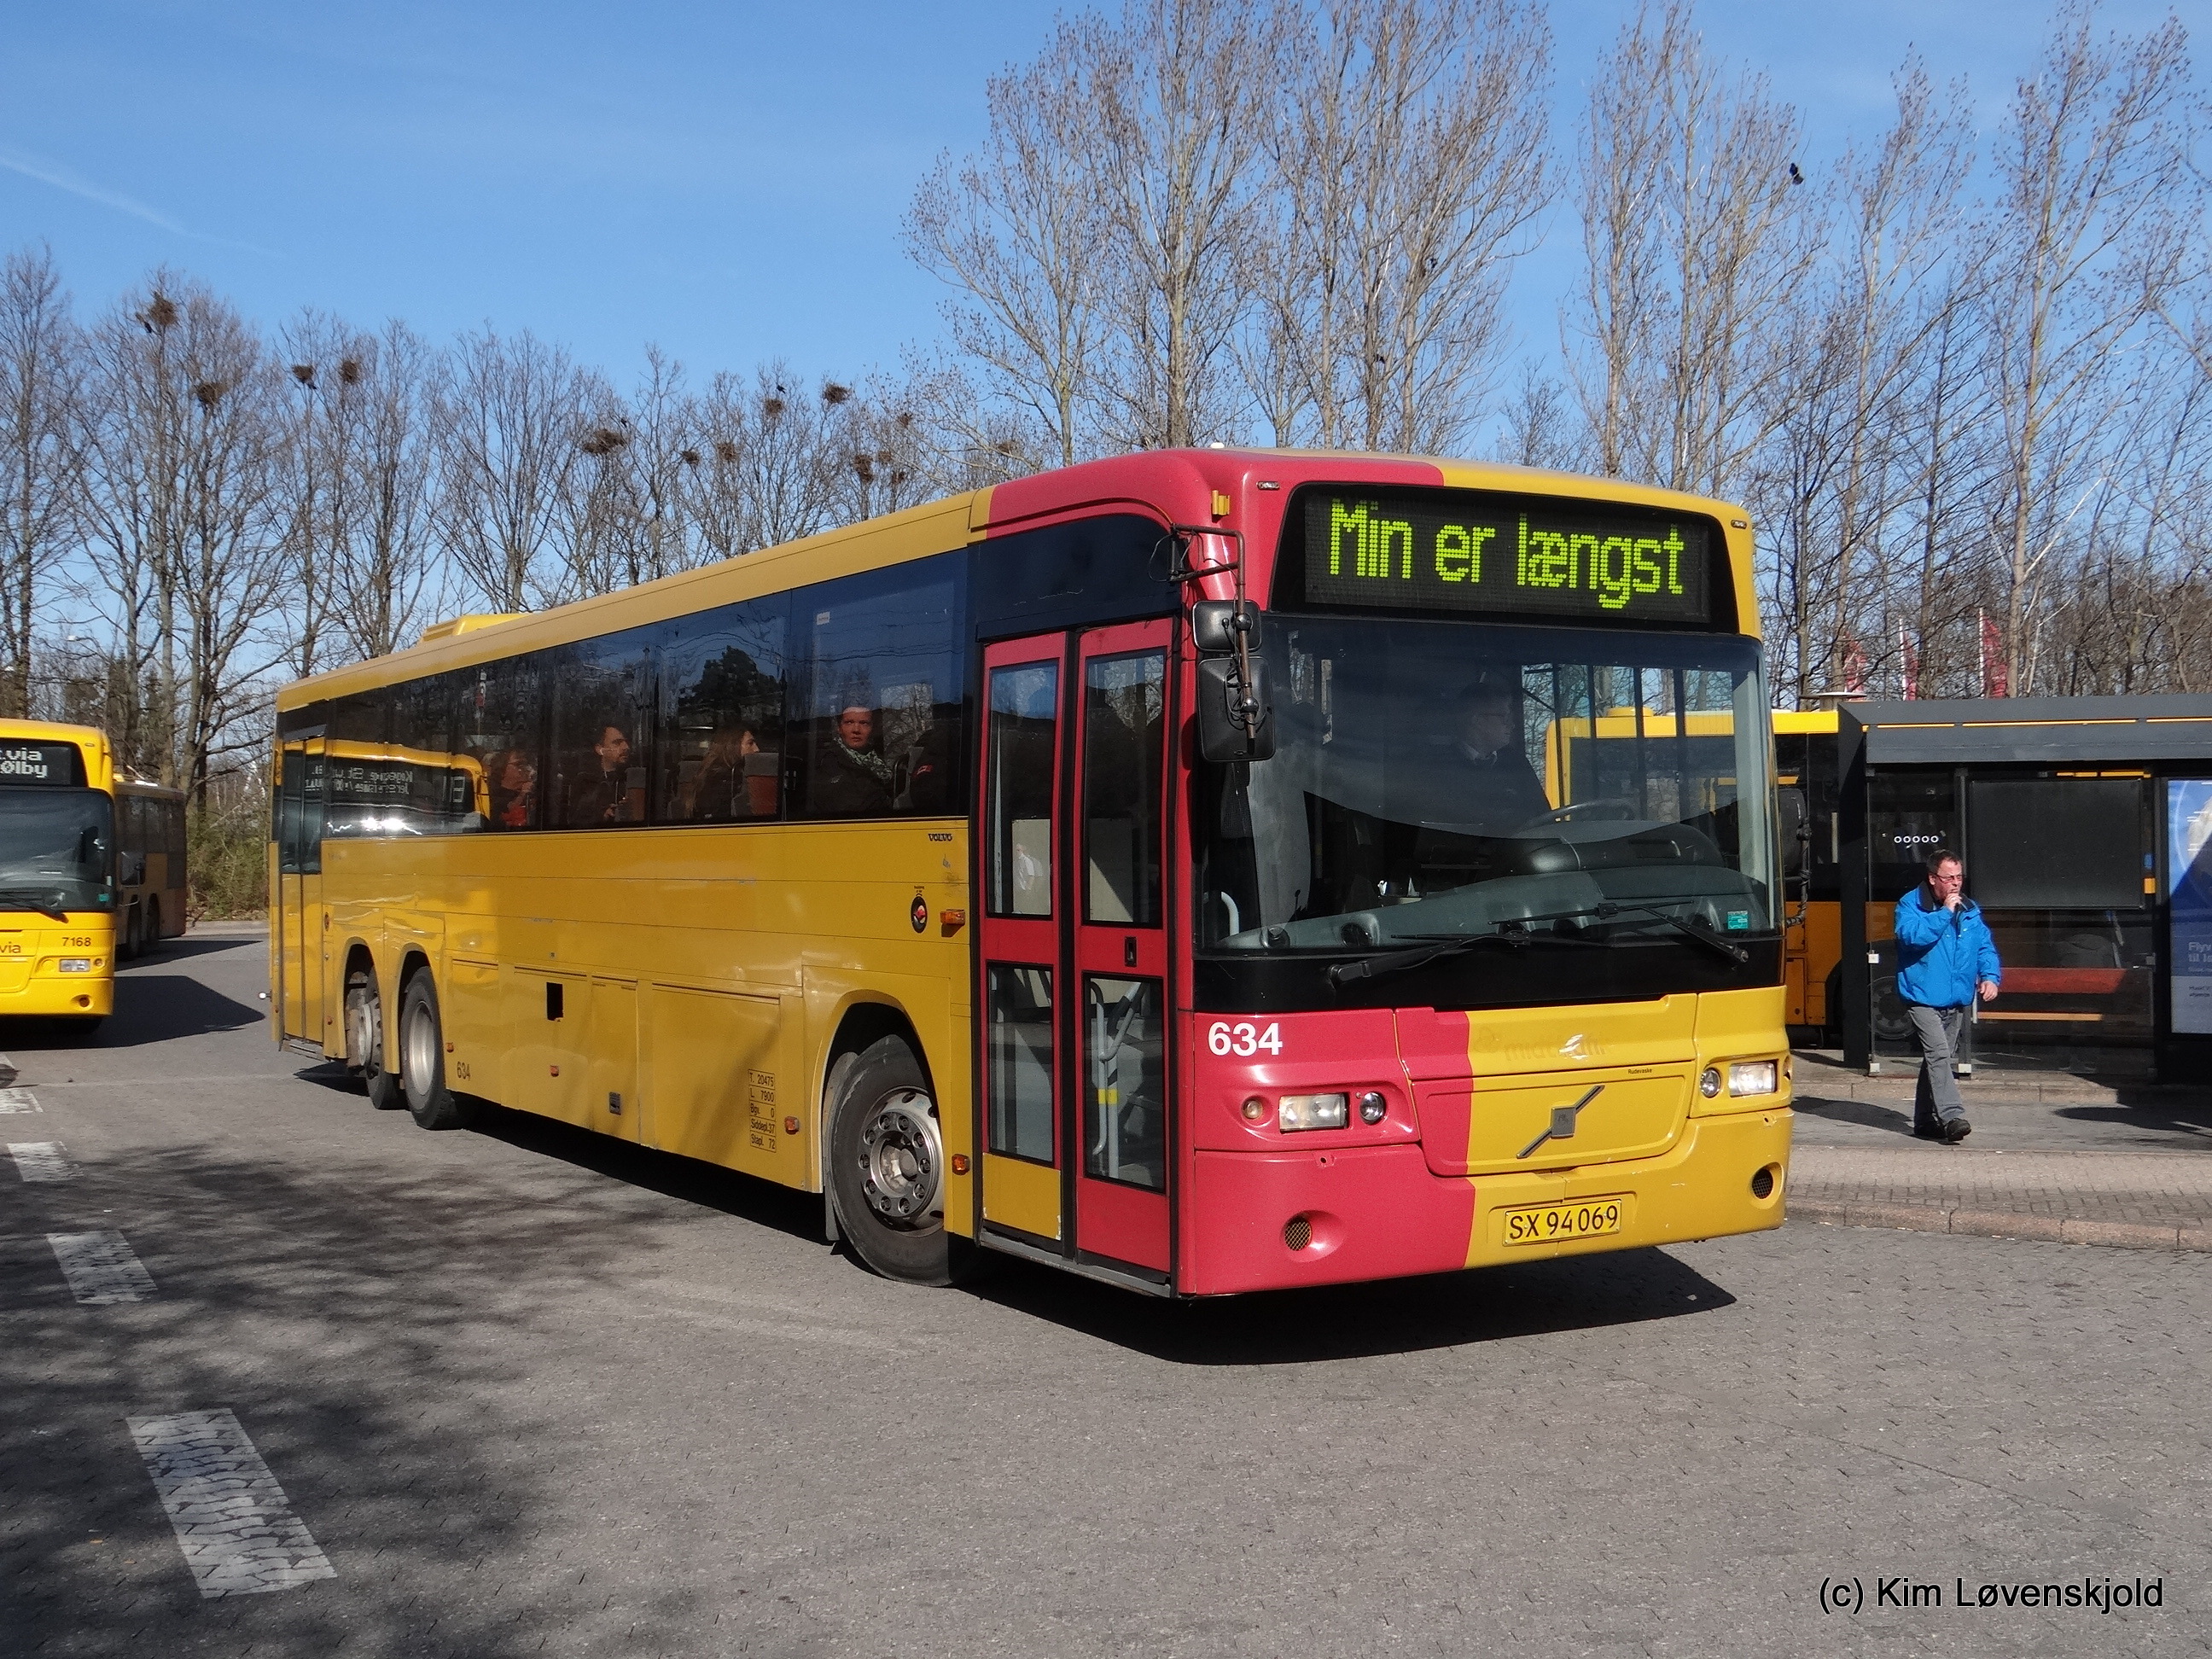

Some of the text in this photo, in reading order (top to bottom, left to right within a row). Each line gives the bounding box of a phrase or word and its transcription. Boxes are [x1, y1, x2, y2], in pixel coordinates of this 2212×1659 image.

[1330, 498, 1685, 609] Min er længst
[928, 833, 953, 842] VOLVO
[61, 937, 91, 946] 7168
[1208, 1022, 1283, 1057] 634
[457, 1061, 471, 1081] 634
[757, 1074, 774, 1087] 20475
[760, 1090, 775, 1103] 7900
[769, 1138, 776, 1150] 72
[1509, 1214, 1540, 1240] SX
